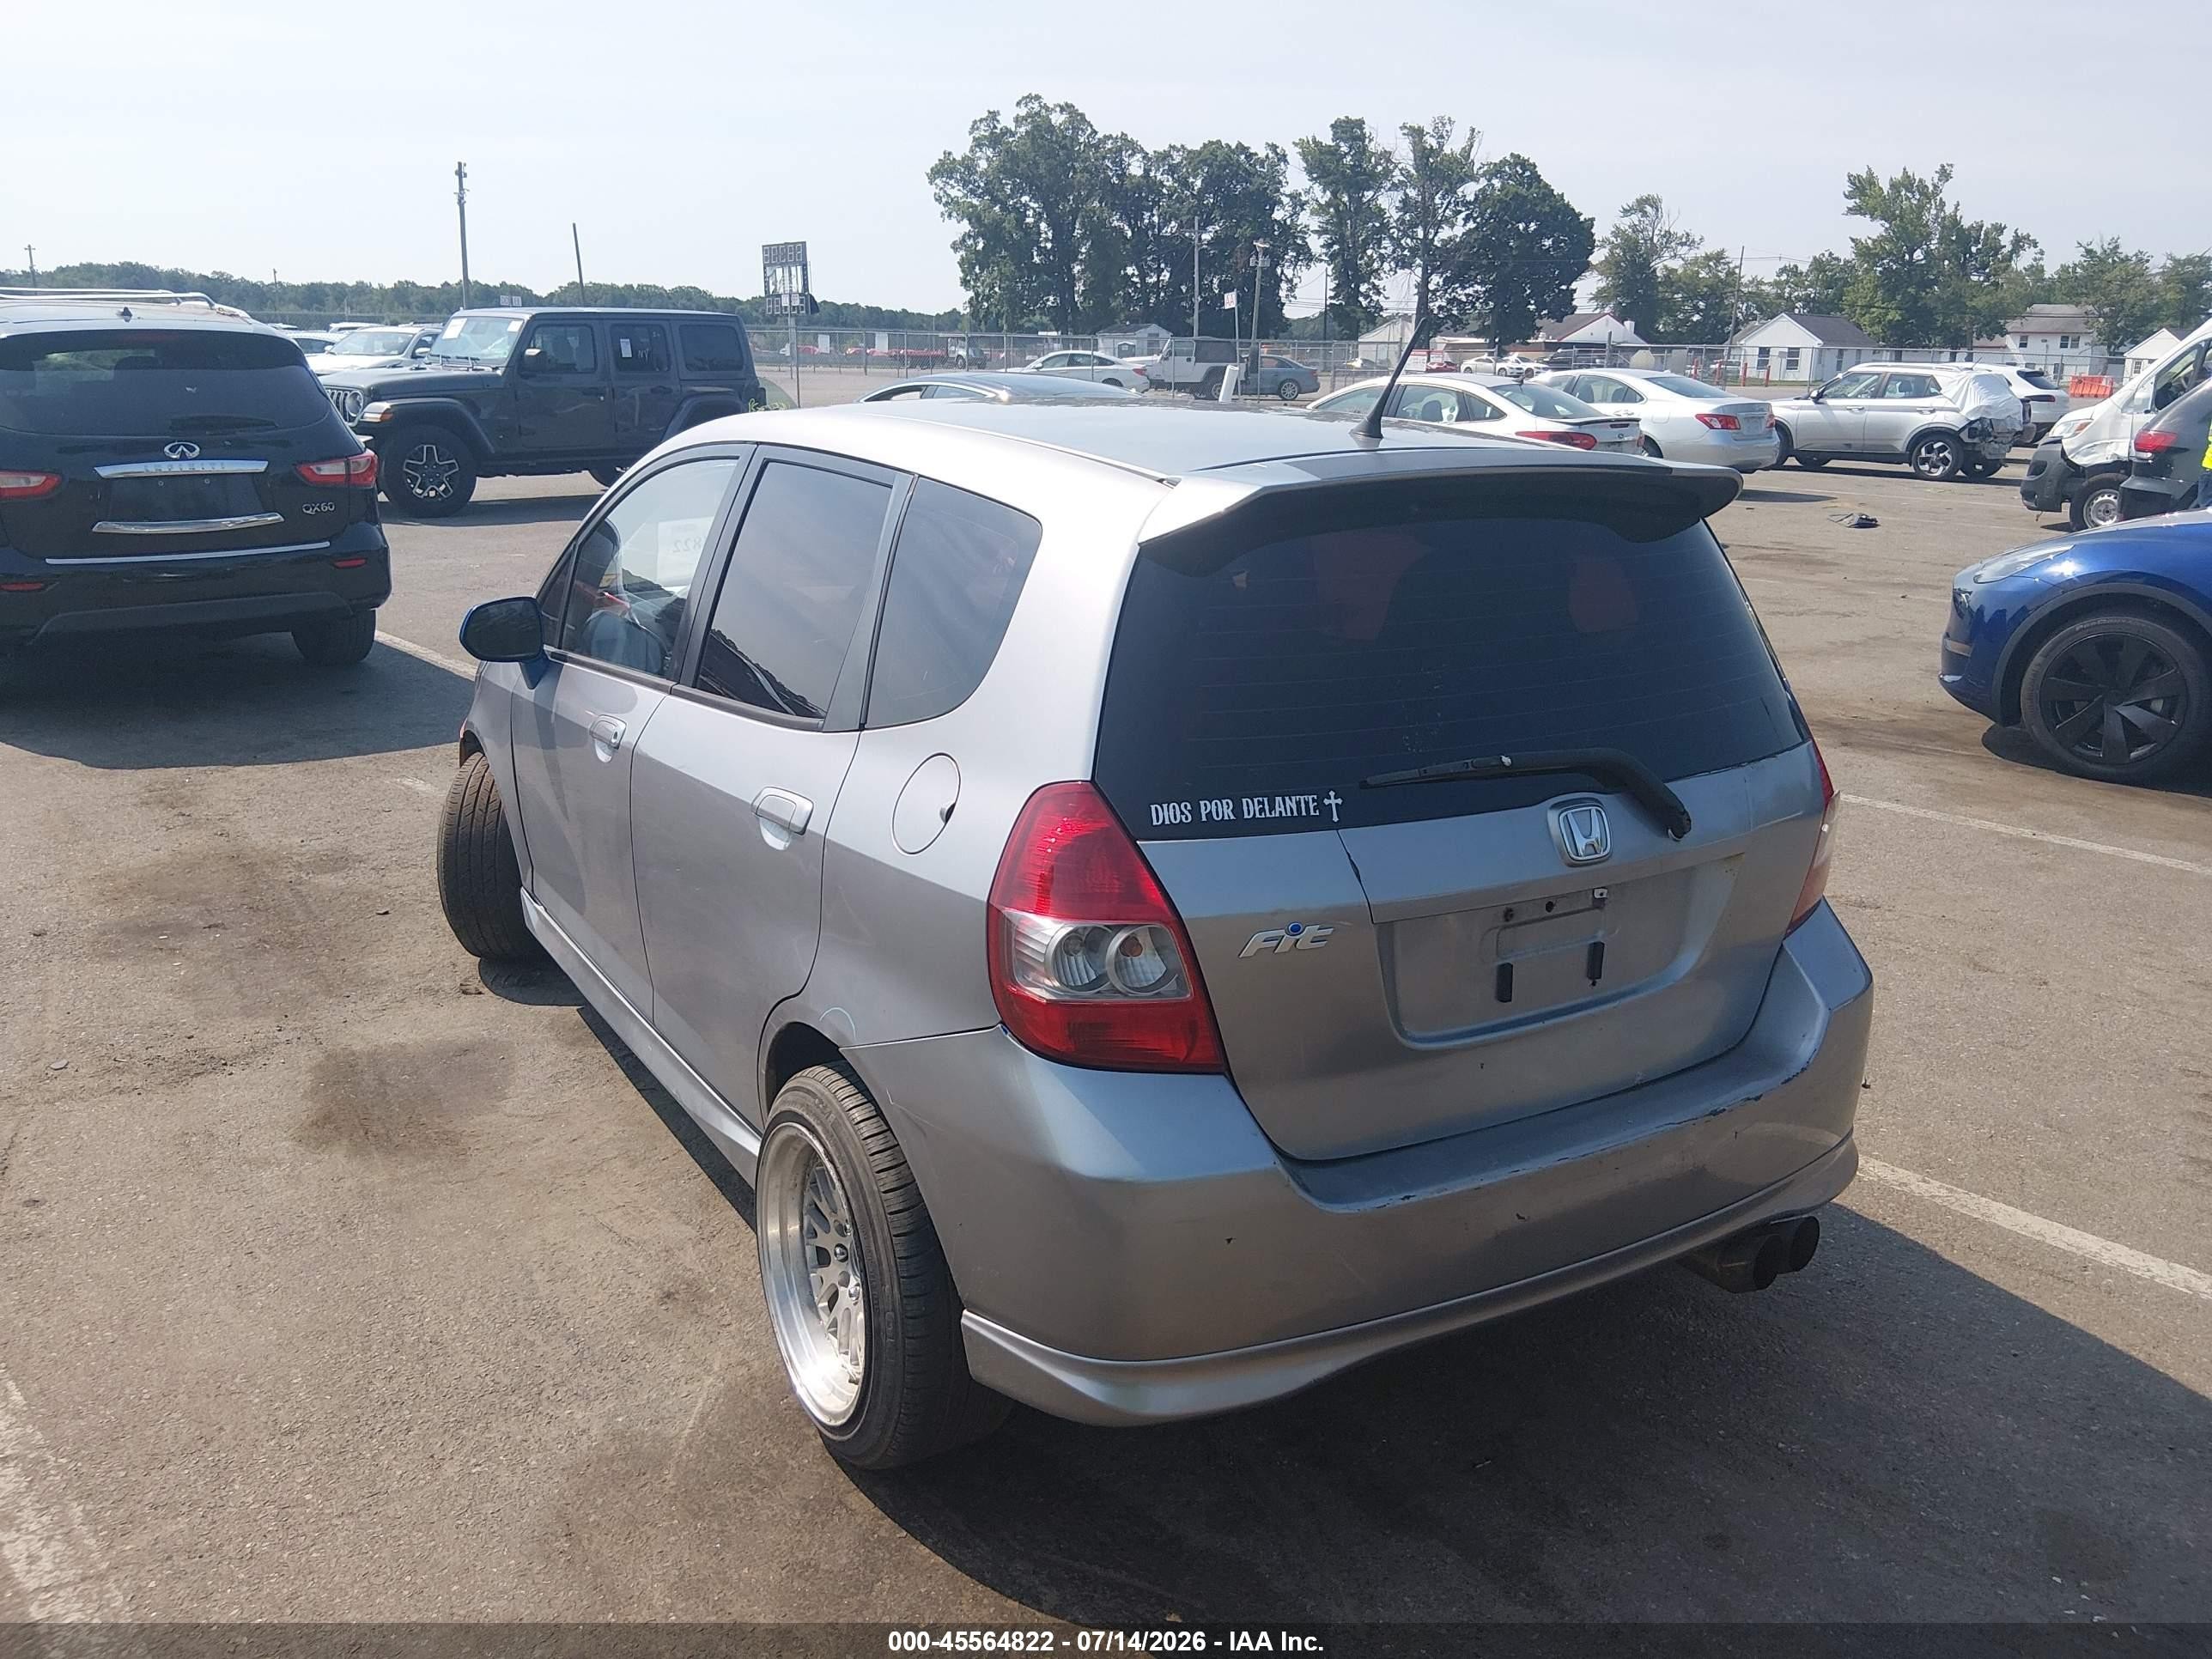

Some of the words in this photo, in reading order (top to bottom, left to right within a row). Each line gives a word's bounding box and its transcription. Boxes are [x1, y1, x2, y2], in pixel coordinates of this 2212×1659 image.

[302, 501, 335, 514] QX60
[1150, 802, 1192, 825] DIOS
[1199, 799, 1236, 822] POR
[1242, 795, 1319, 819] DELANTE
